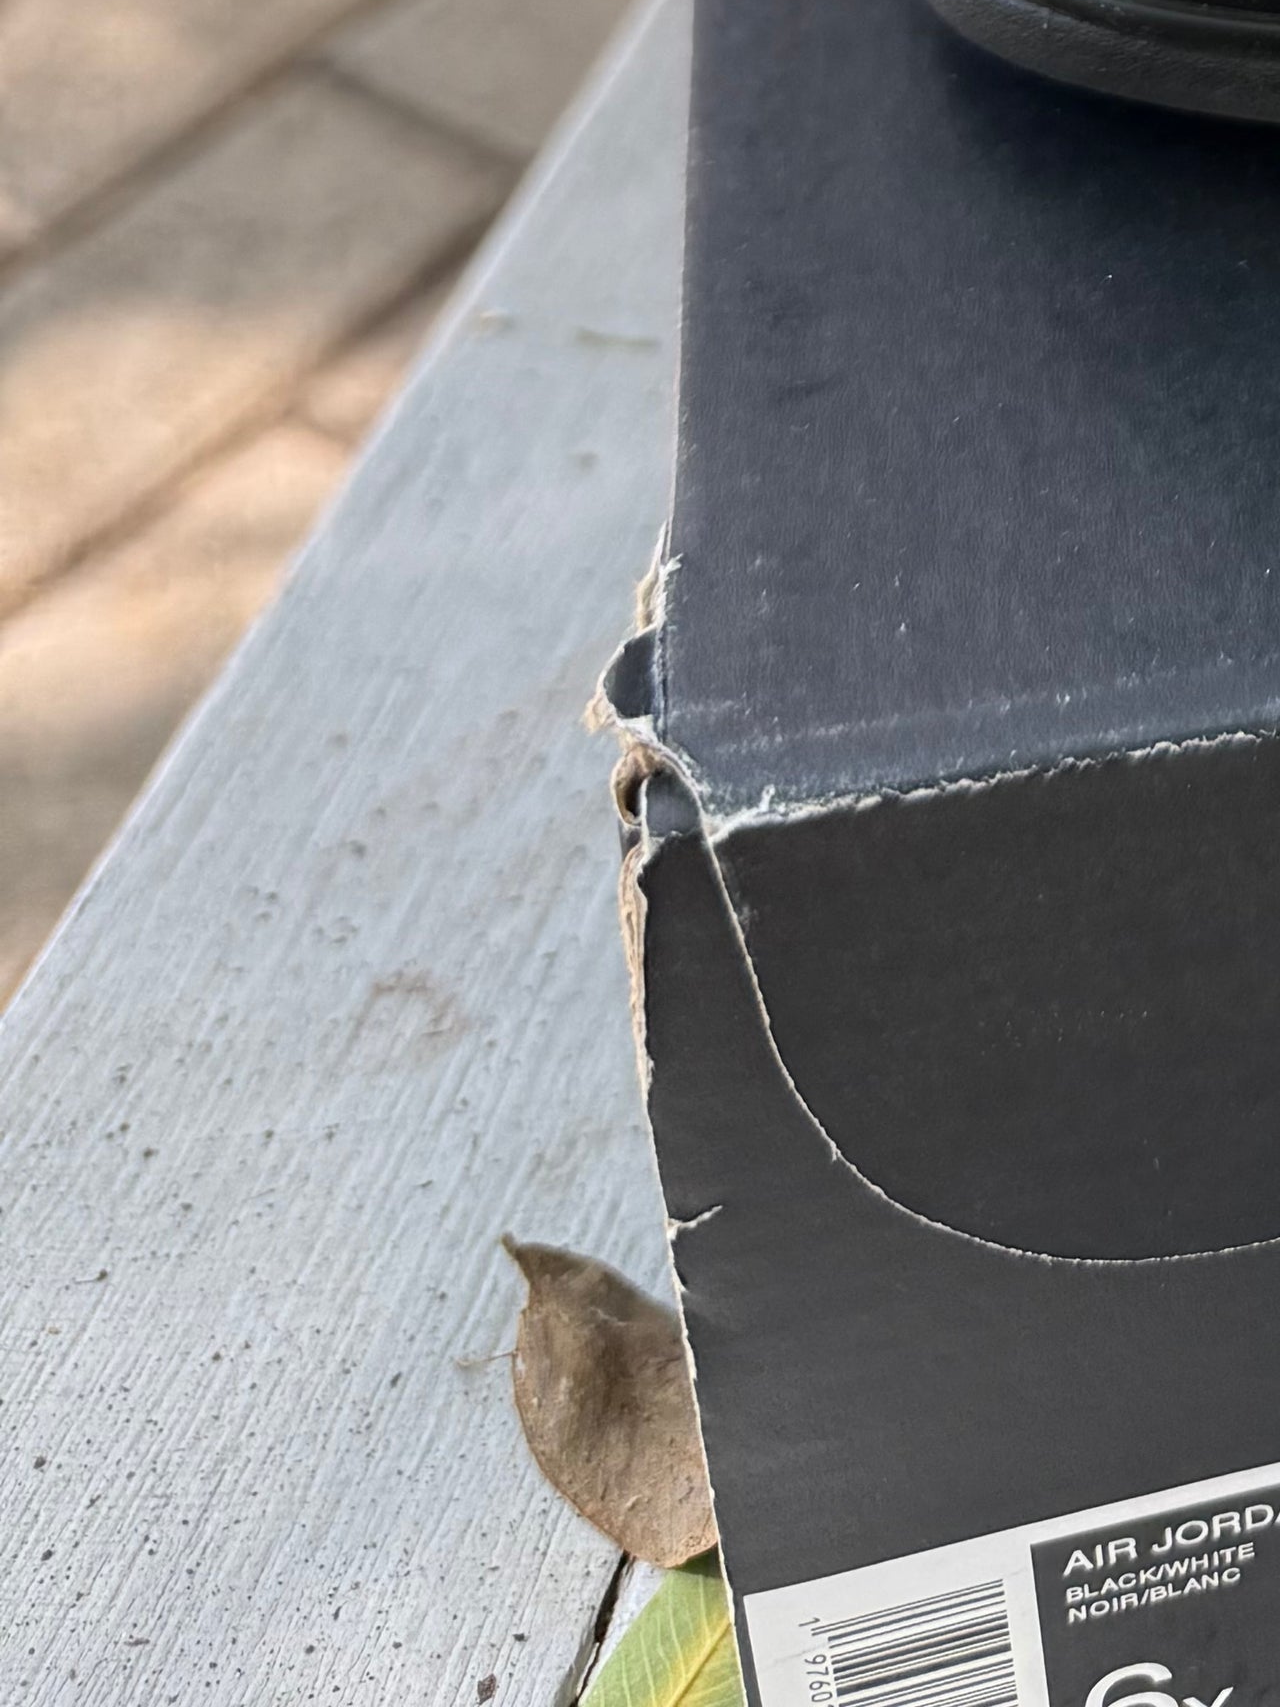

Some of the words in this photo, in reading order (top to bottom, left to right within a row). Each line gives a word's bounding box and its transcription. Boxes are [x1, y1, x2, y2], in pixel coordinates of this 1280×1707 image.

[1063, 1537, 1137, 1576] AIR
[1066, 1542, 1255, 1603] BLACK/WHITE
[1068, 1567, 1241, 1623] NOIR/BLANC
[804, 1654, 833, 1707] 9760
